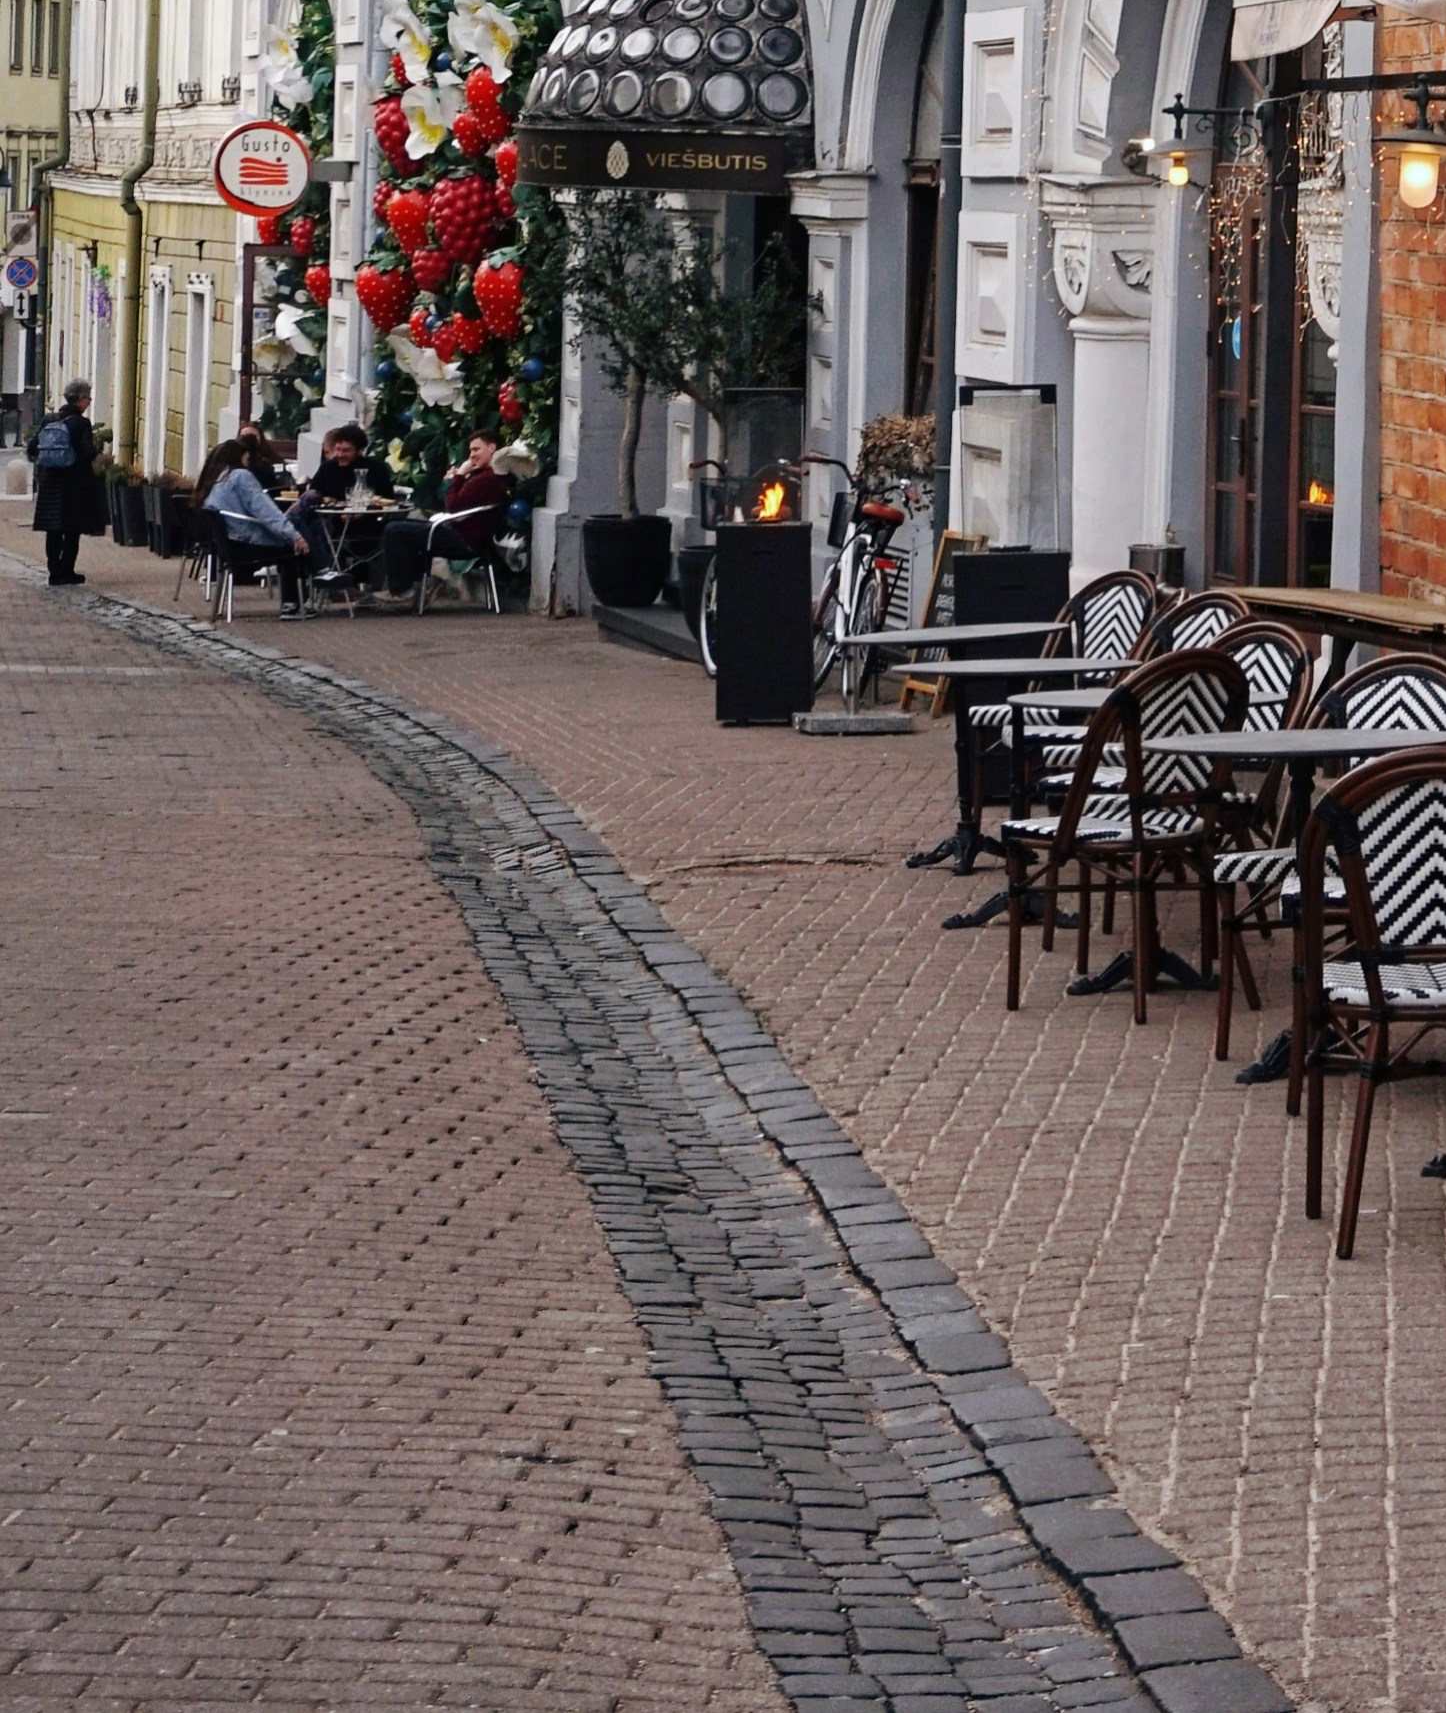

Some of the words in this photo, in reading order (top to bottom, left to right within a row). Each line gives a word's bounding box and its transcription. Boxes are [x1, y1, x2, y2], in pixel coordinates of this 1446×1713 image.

[241, 133, 291, 153] Gusto
[521, 143, 568, 171] ACE
[646, 148, 768, 171] VIEŠBUTIS
